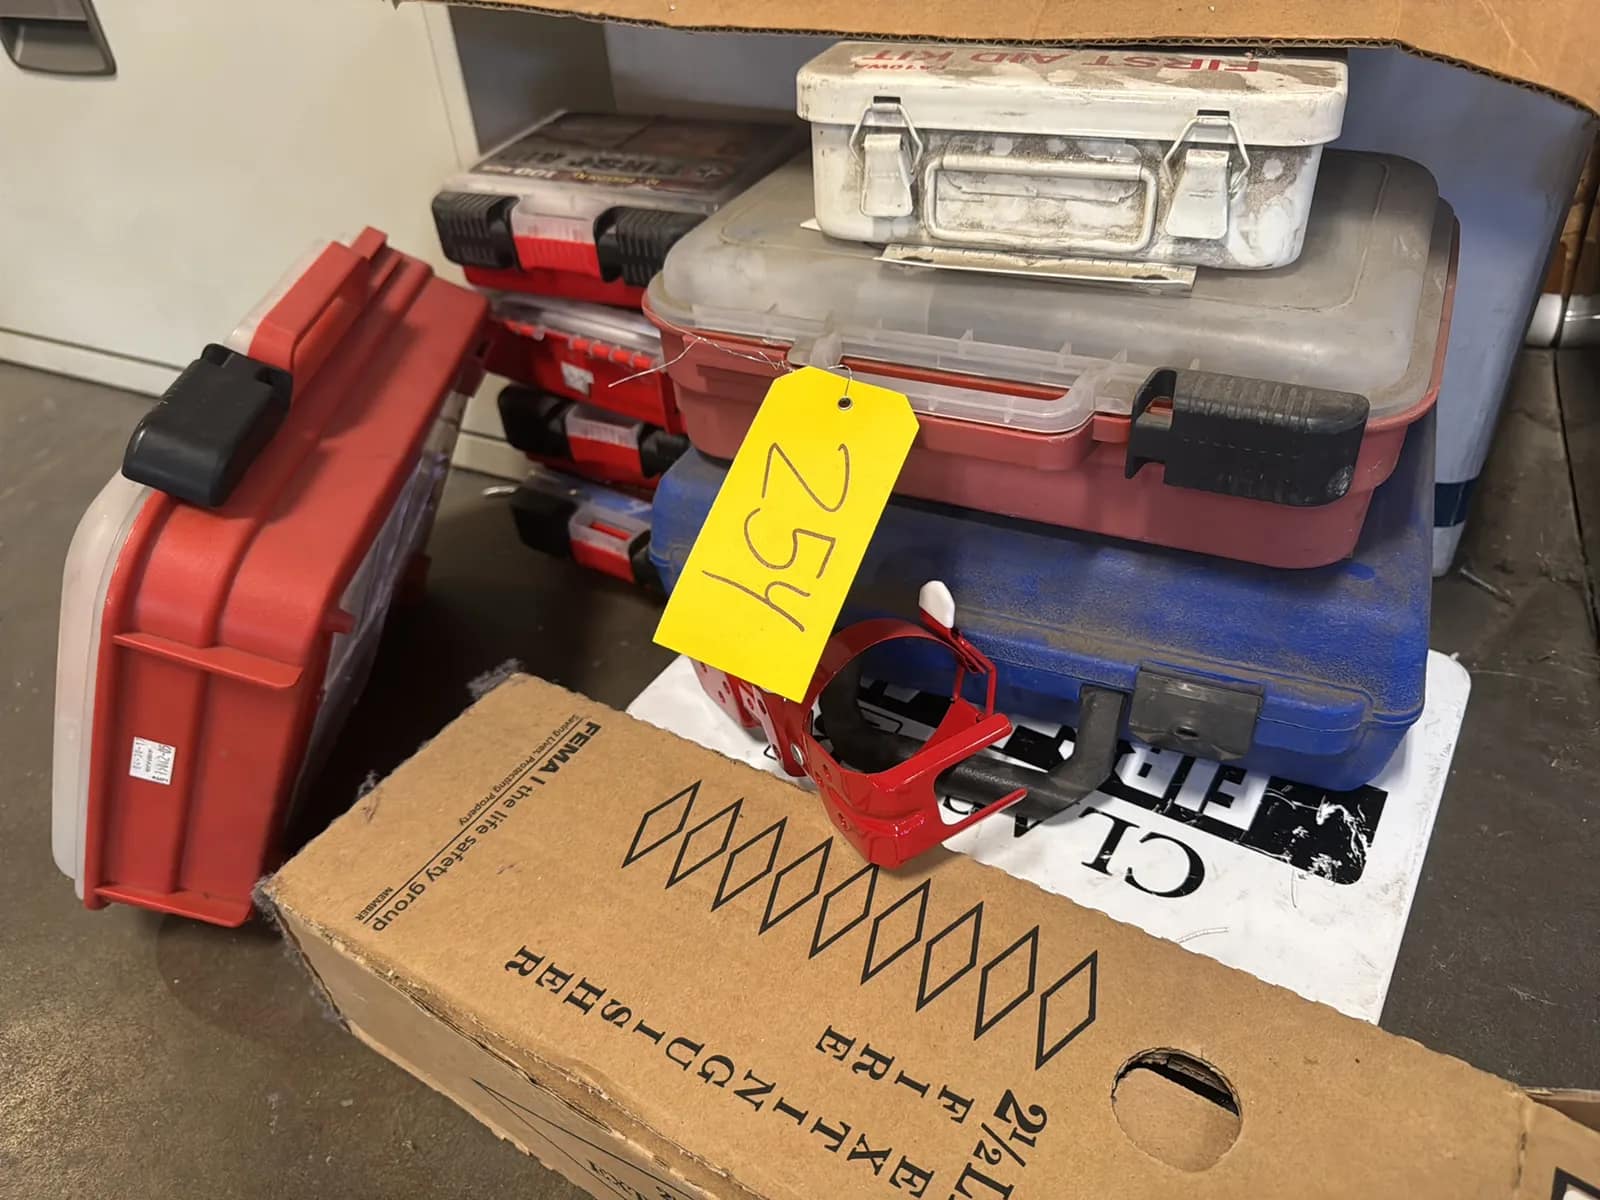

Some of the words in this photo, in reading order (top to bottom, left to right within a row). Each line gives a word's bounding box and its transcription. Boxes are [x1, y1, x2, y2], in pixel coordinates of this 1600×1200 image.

[870, 49, 954, 63] KIT
[969, 51, 1071, 66] AID
[1081, 53, 1260, 73] FIRST
[702, 442, 851, 633] 254
[552, 714, 580, 738] Saving
[532, 735, 557, 755] Lives,
[539, 721, 603, 775] FEMA
[491, 754, 537, 794] Protecting
[457, 792, 498, 827] Property
[502, 783, 534, 810] the
[474, 809, 508, 836] life
[424, 835, 478, 883] safety
[354, 886, 395, 922] MEMBER
[371, 881, 427, 933] group
[503, 945, 936, 1200] EXTINGUISHER
[815, 1025, 976, 1125] FIRE
